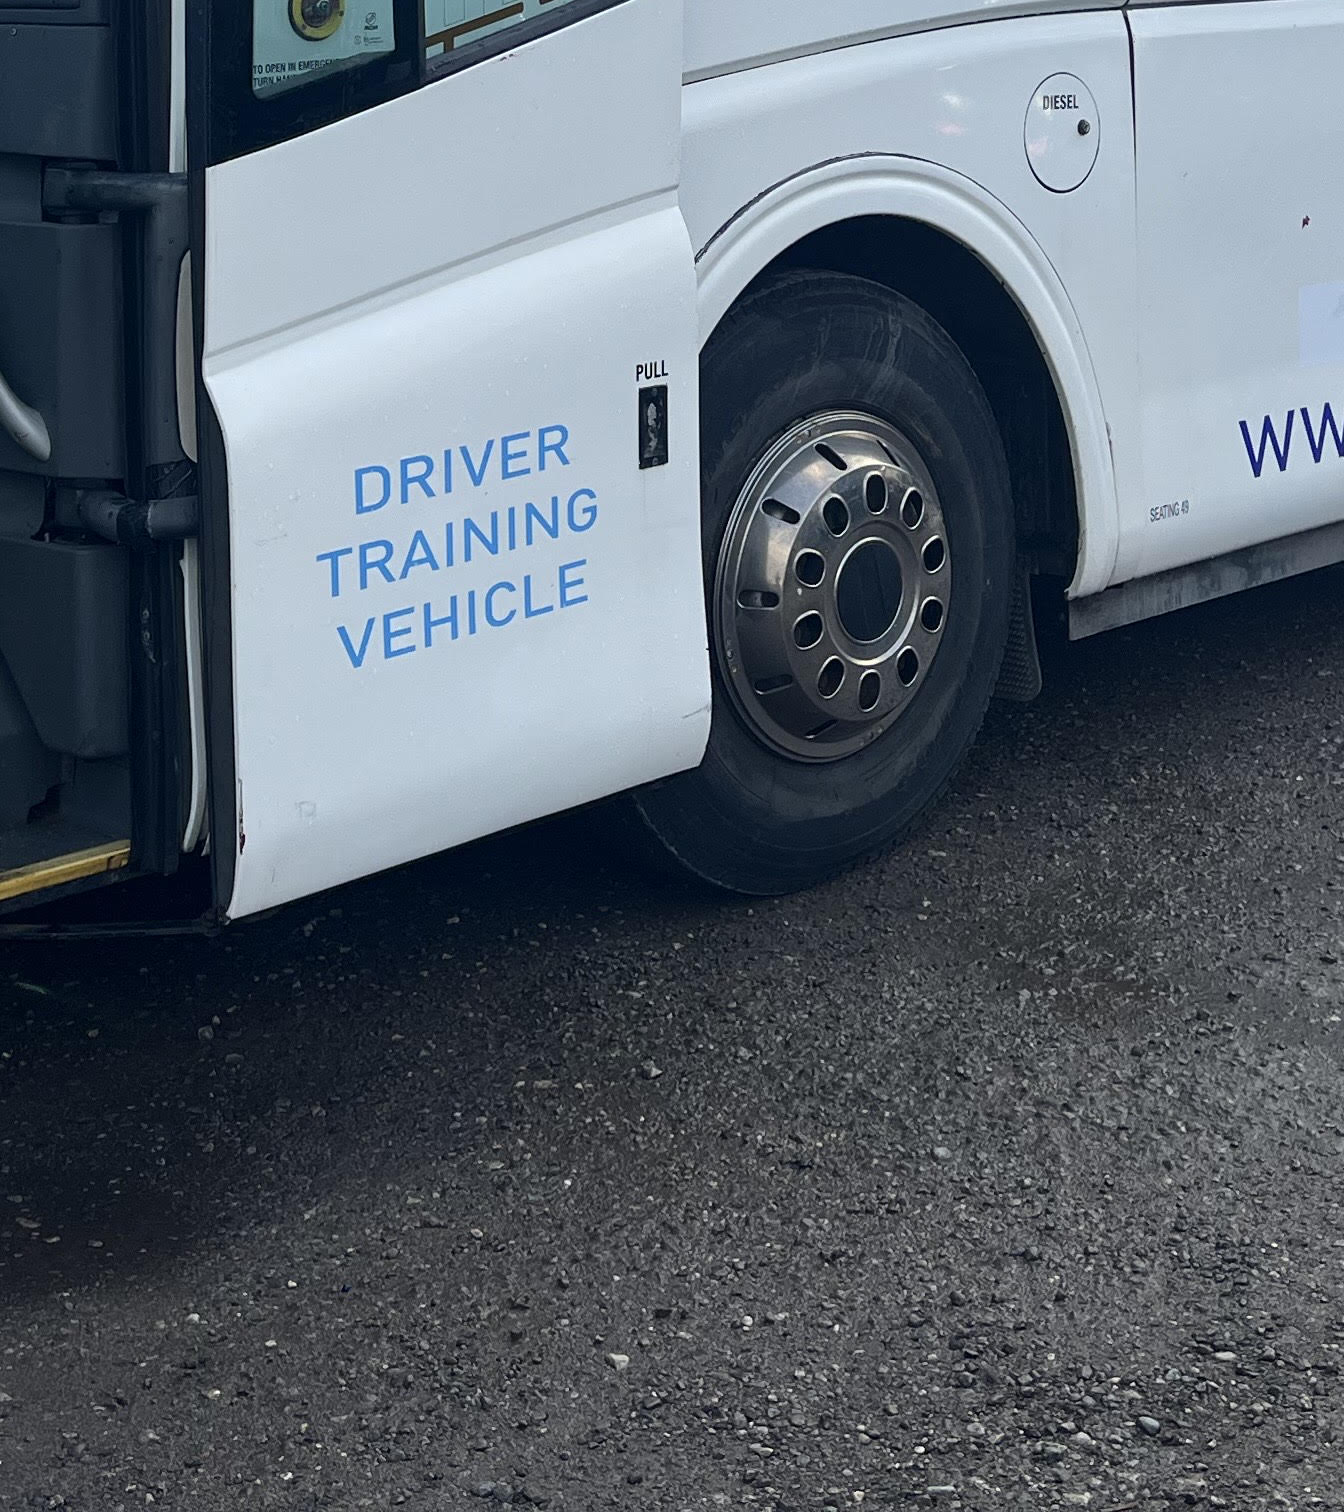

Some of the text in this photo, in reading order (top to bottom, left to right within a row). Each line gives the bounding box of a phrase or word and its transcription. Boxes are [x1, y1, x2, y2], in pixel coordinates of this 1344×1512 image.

[265, 62, 286, 74] OPEN
[1043, 94, 1080, 110] DIESEL
[636, 359, 669, 382] PULL
[353, 424, 571, 515] DRIVER
[1150, 501, 1180, 523] SEATING
[316, 488, 598, 598] TRAINING
[336, 559, 589, 669] VEHICLE
